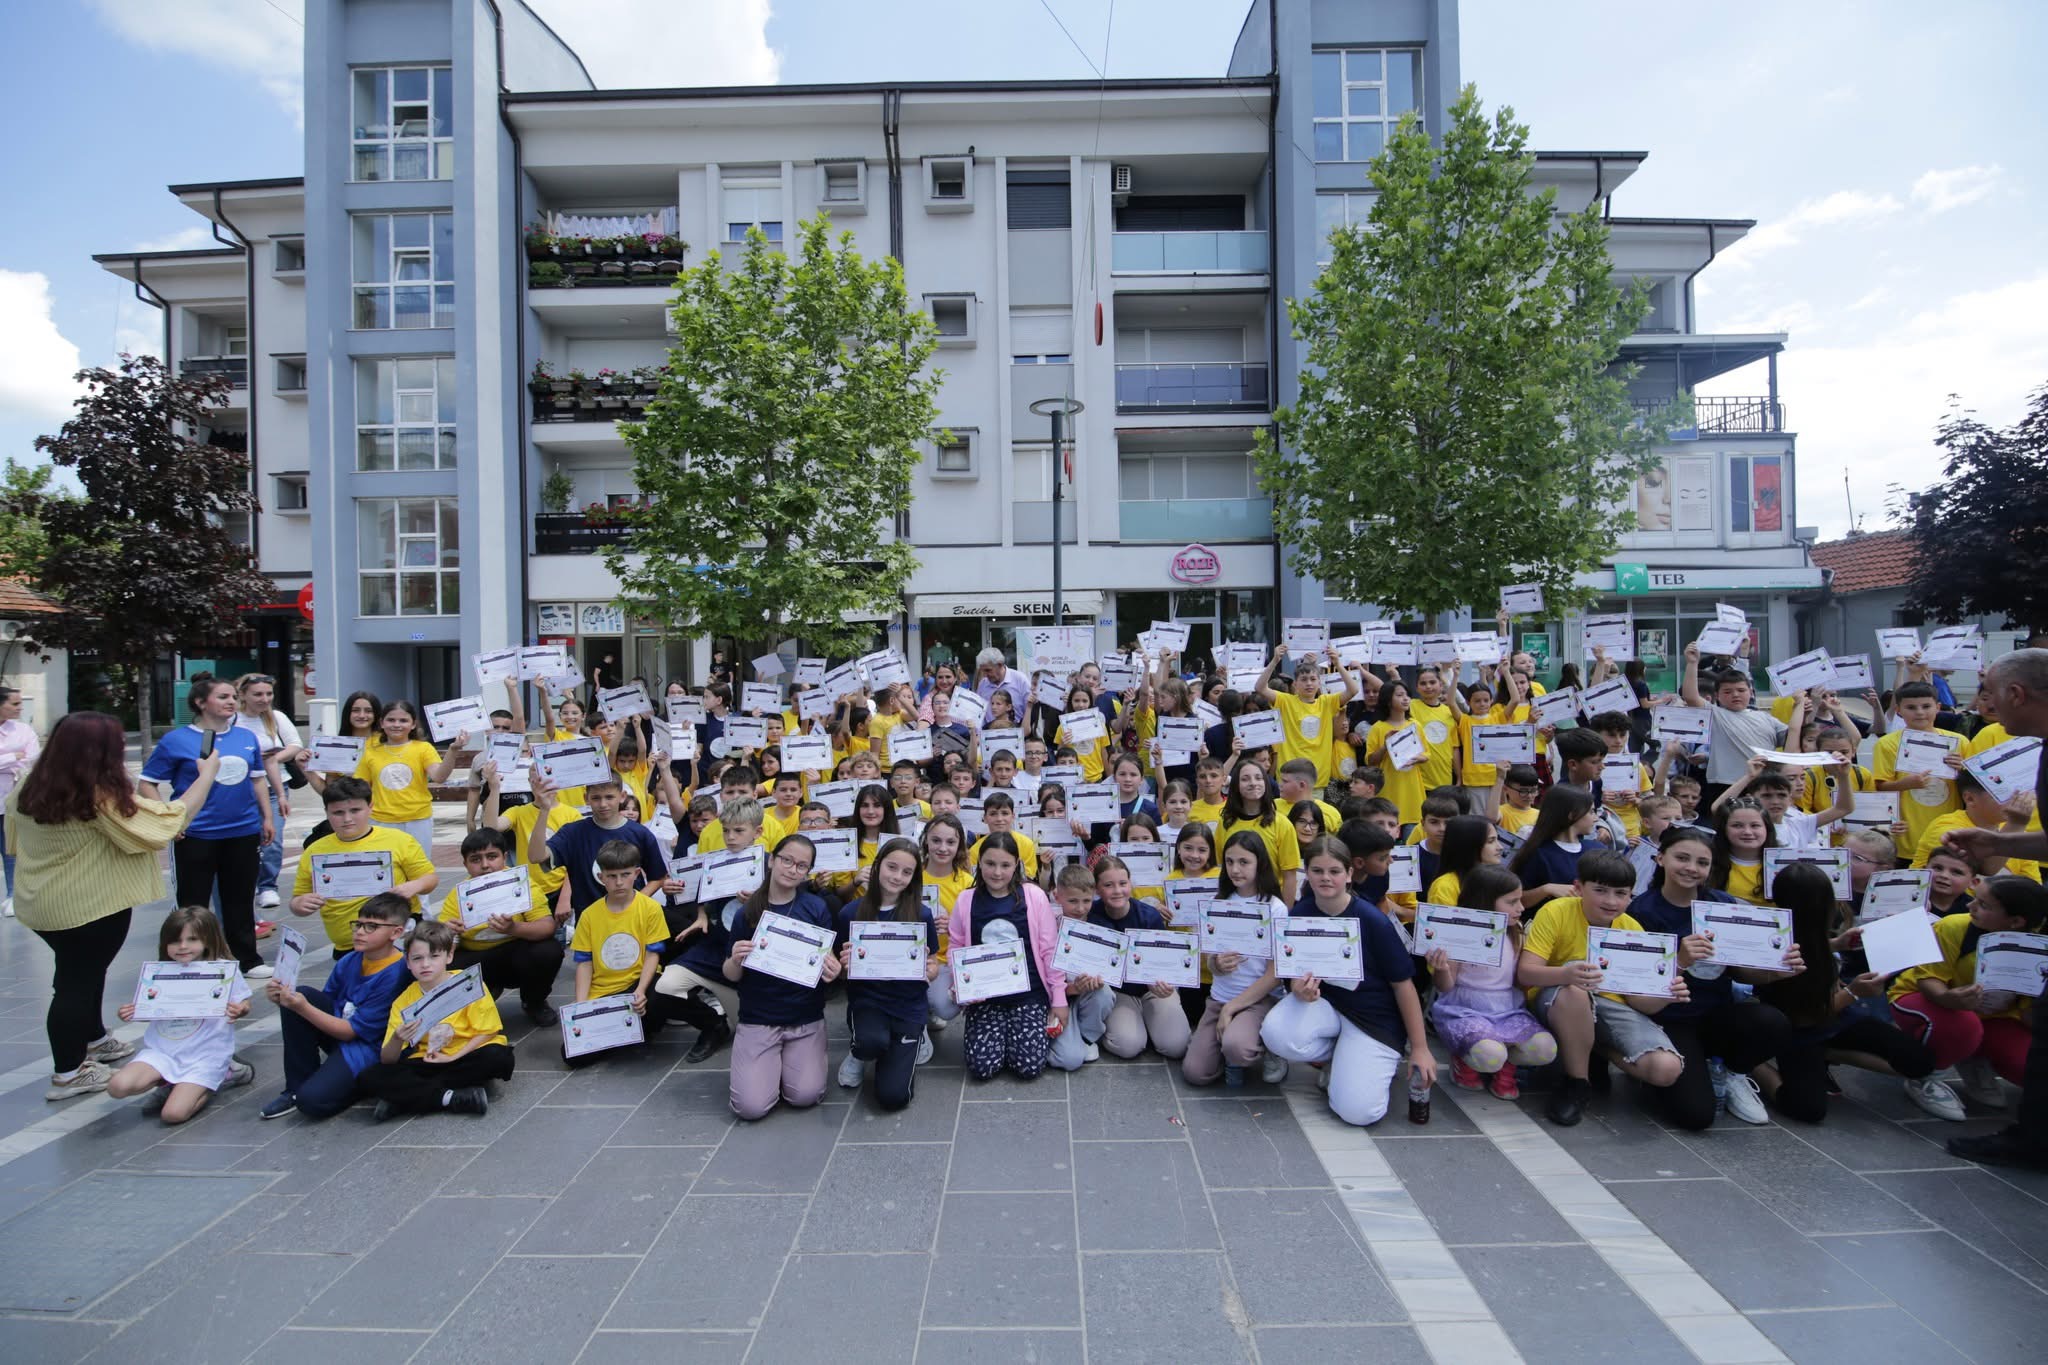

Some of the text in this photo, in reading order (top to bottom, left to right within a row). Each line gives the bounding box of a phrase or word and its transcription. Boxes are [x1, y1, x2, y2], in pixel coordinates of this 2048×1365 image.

[1651, 573, 1685, 585] TEB
[952, 603, 1071, 616] Butiku SKENA
